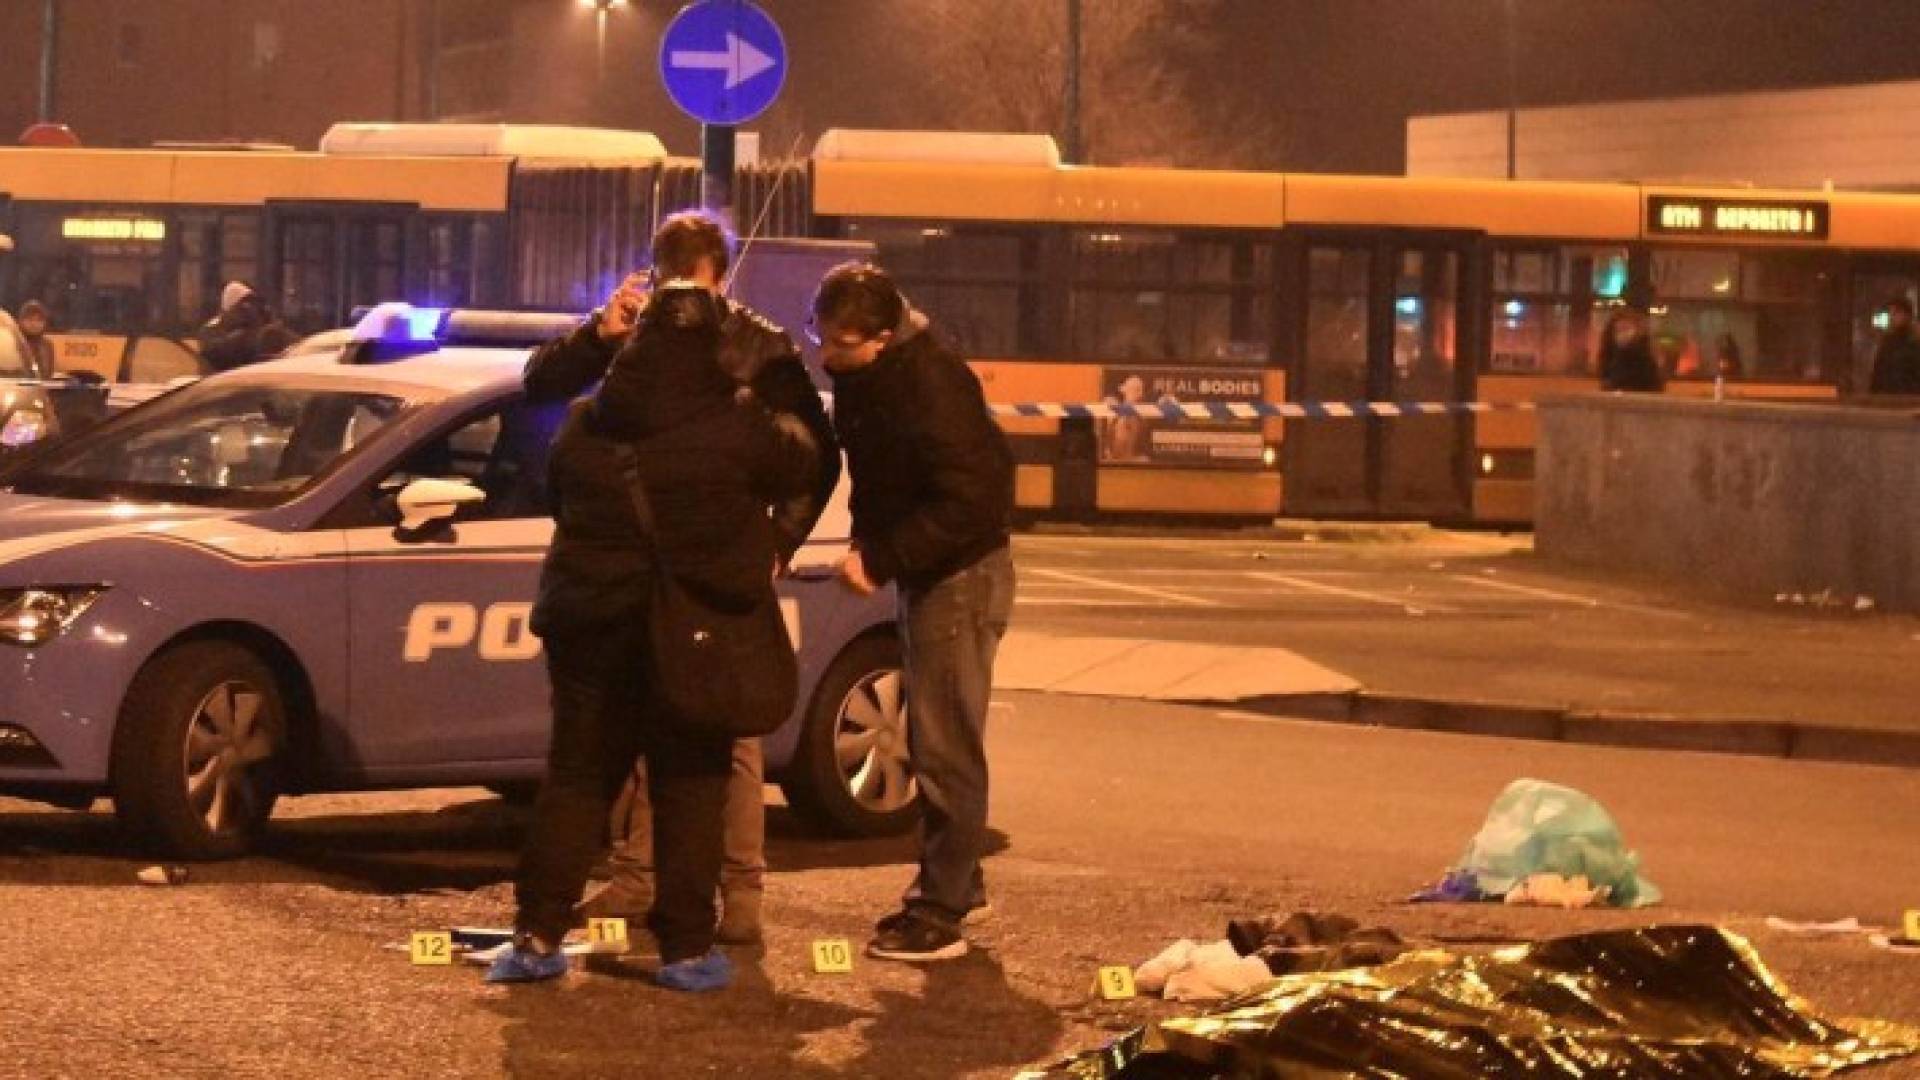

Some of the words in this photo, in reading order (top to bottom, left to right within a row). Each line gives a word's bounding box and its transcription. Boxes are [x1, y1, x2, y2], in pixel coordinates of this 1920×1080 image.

[1153, 377, 1197, 394] REAL
[1198, 379, 1260, 396] BODIES
[417, 936, 446, 957] 12
[819, 944, 847, 965] 10
[1110, 970, 1125, 992] 9
